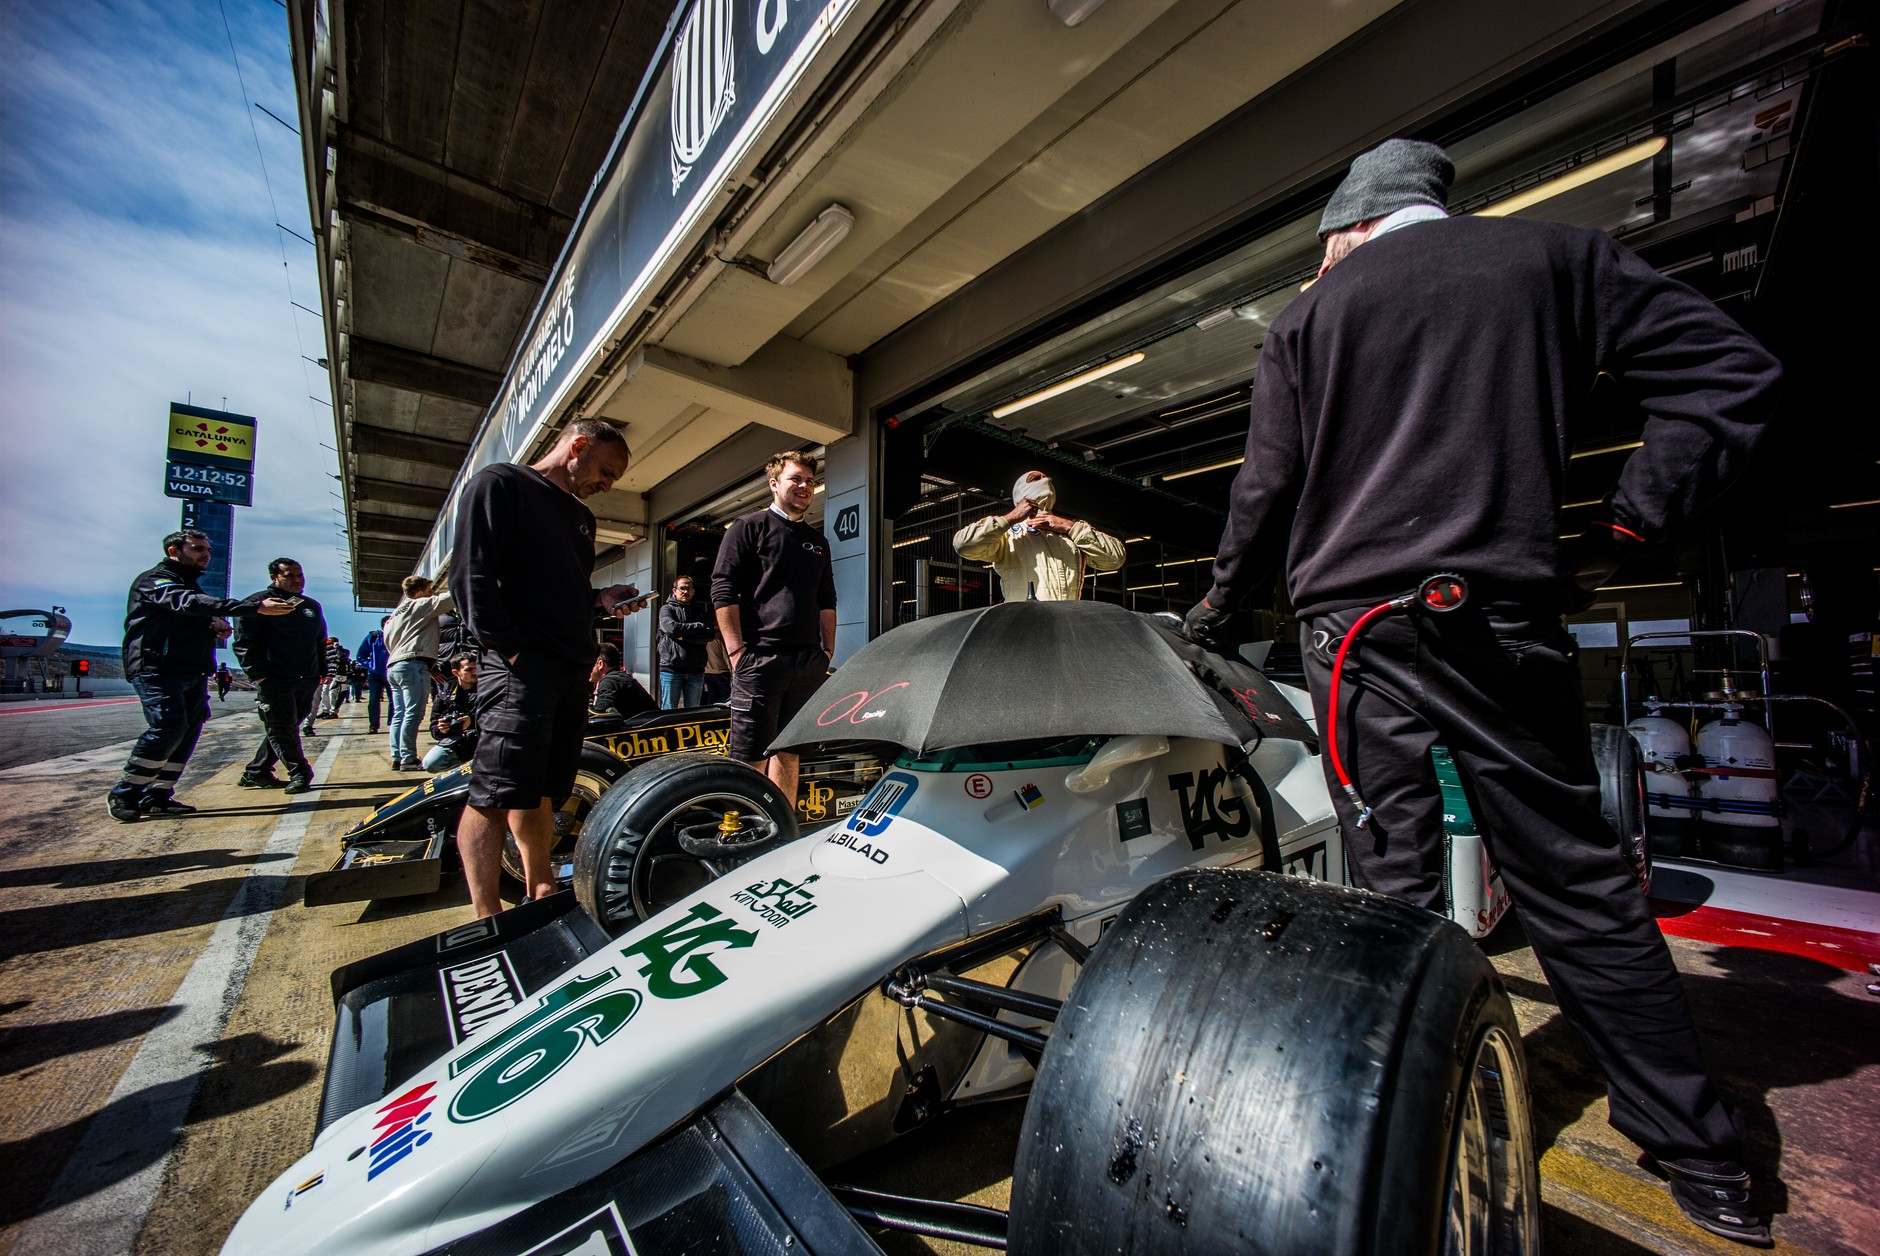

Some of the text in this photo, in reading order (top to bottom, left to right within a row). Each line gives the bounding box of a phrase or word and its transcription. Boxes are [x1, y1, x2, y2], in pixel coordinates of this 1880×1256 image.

[518, 264, 576, 389] AJUNTAMENT DE
[518, 298, 574, 424] MONTMELÓ
[175, 428, 247, 446] CATALUNYA
[169, 481, 213, 496] VOLTA
[172, 465, 246, 487] 12:12:52
[186, 503, 194, 513] 1
[185, 517, 194, 527] 2
[839, 511, 858, 535] 40
[605, 732, 671, 759] John
[972, 778, 986, 793] E
[1168, 761, 1252, 851] TAG
[825, 831, 889, 865] ALBILAD
[619, 901, 760, 1000] TAG
[447, 966, 643, 1125] 16
